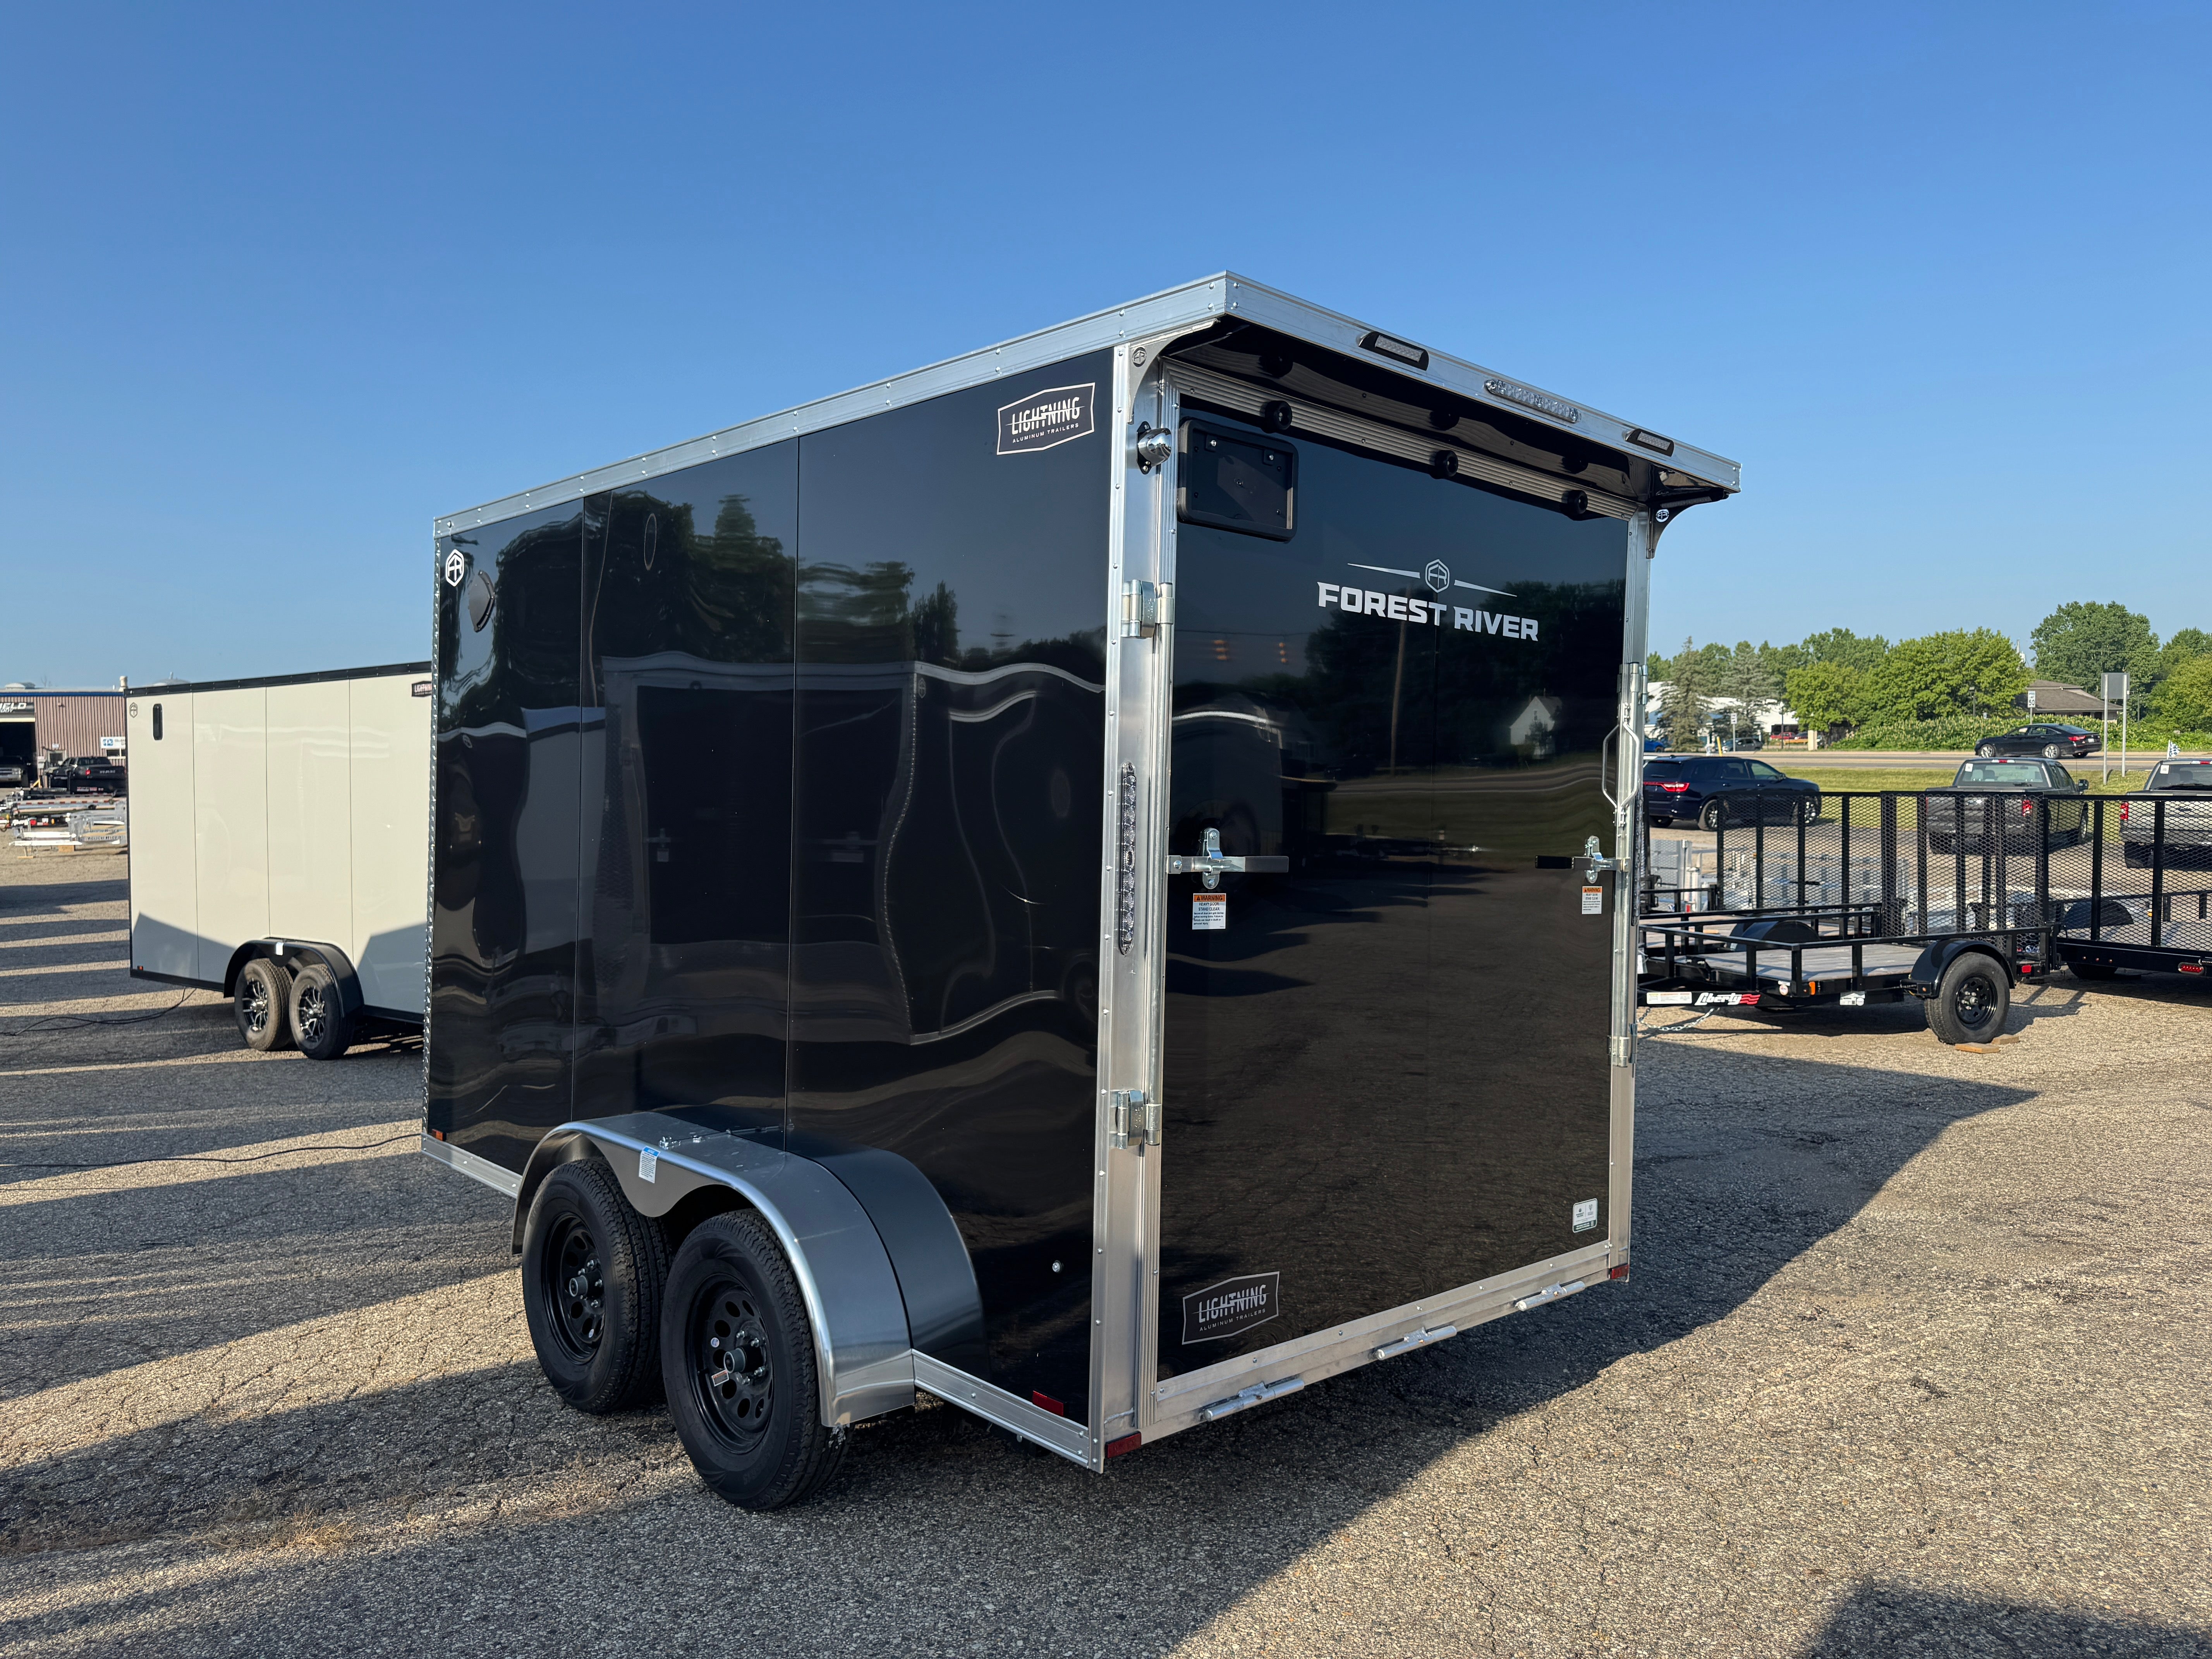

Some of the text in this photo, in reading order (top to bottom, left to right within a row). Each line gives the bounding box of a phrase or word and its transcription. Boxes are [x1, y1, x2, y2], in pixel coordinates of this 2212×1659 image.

[1012, 397, 1080, 435] LIGHTNING
[1012, 423, 1079, 443] ALUMINUM TRAILERS
[1317, 582, 1539, 642] FOREST RIVER
[1694, 992, 1742, 1006] Liberty
[1199, 1285, 1266, 1323] LIGHTNING
[1199, 1308, 1266, 1332] ALUMINUM TRAILERS
